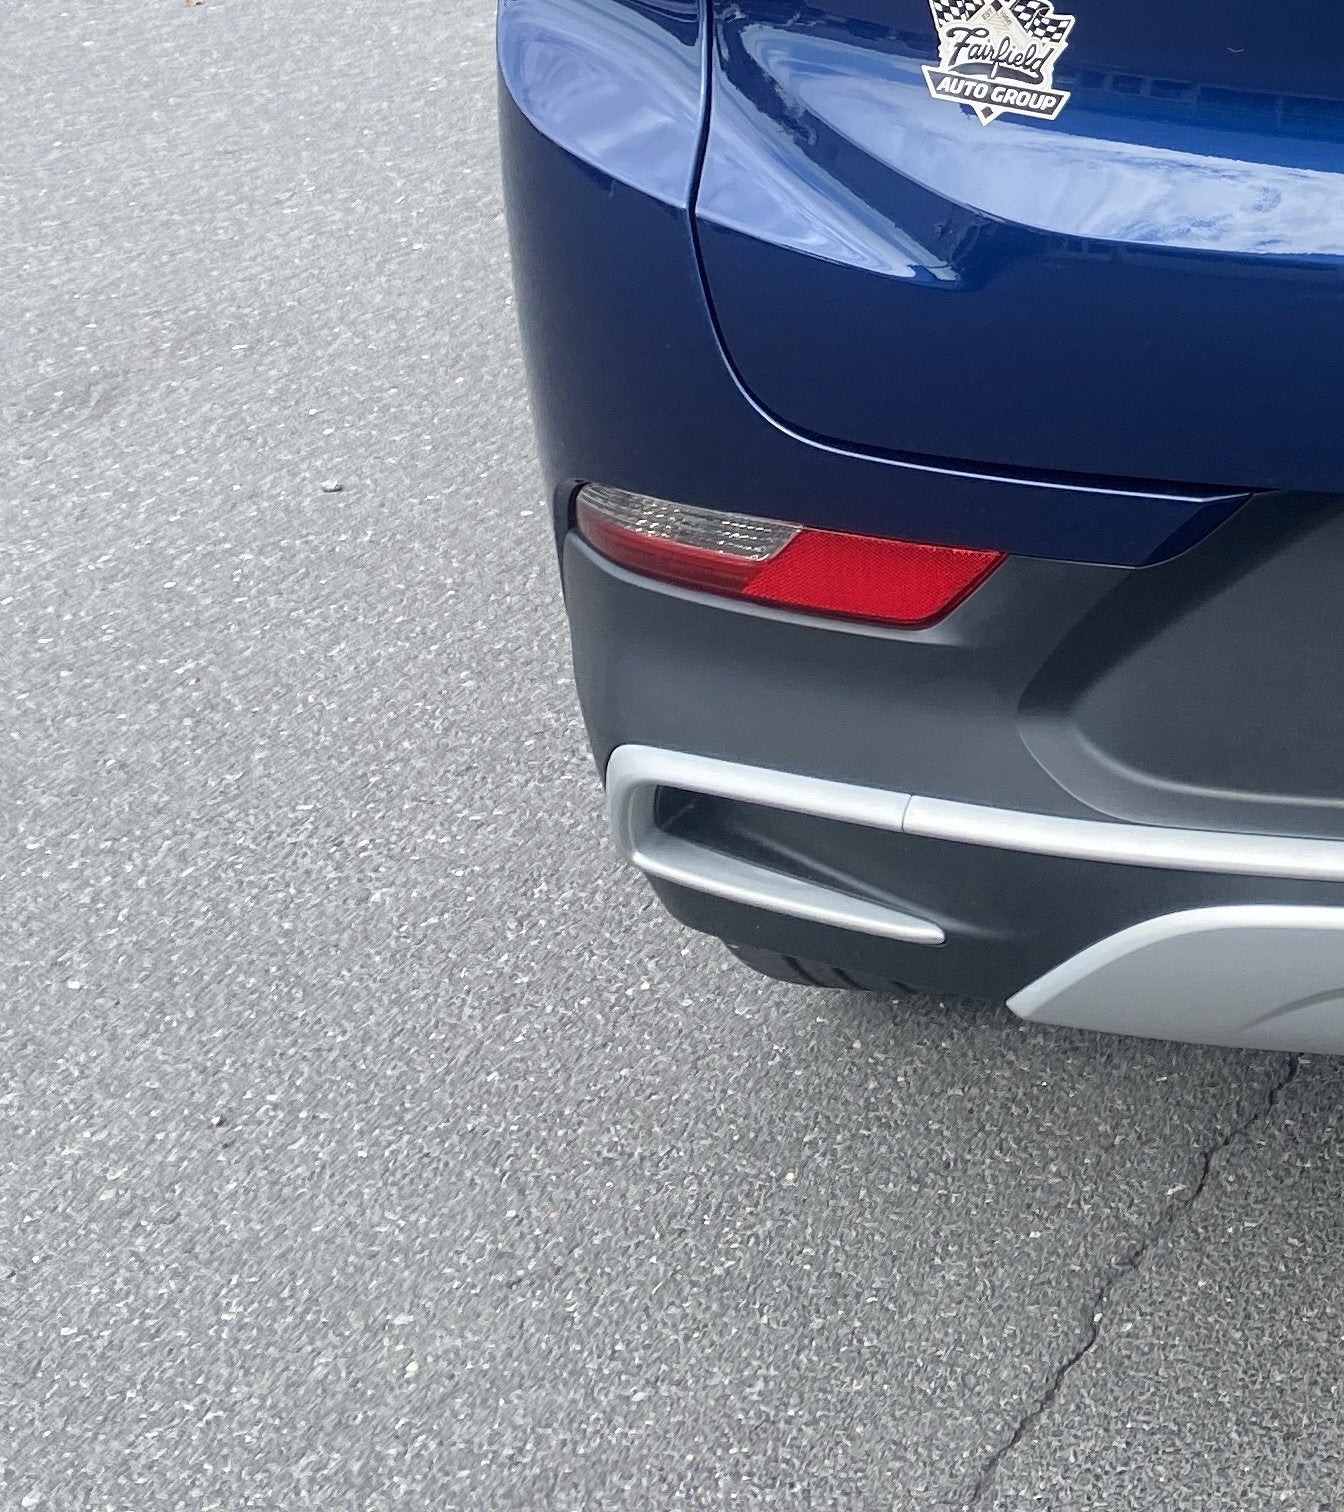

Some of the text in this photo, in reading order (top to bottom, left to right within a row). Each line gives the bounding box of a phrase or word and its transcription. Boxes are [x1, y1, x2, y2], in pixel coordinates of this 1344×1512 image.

[945, 26, 1055, 73] Fairfield
[936, 76, 1057, 111] AUTO GROUP
